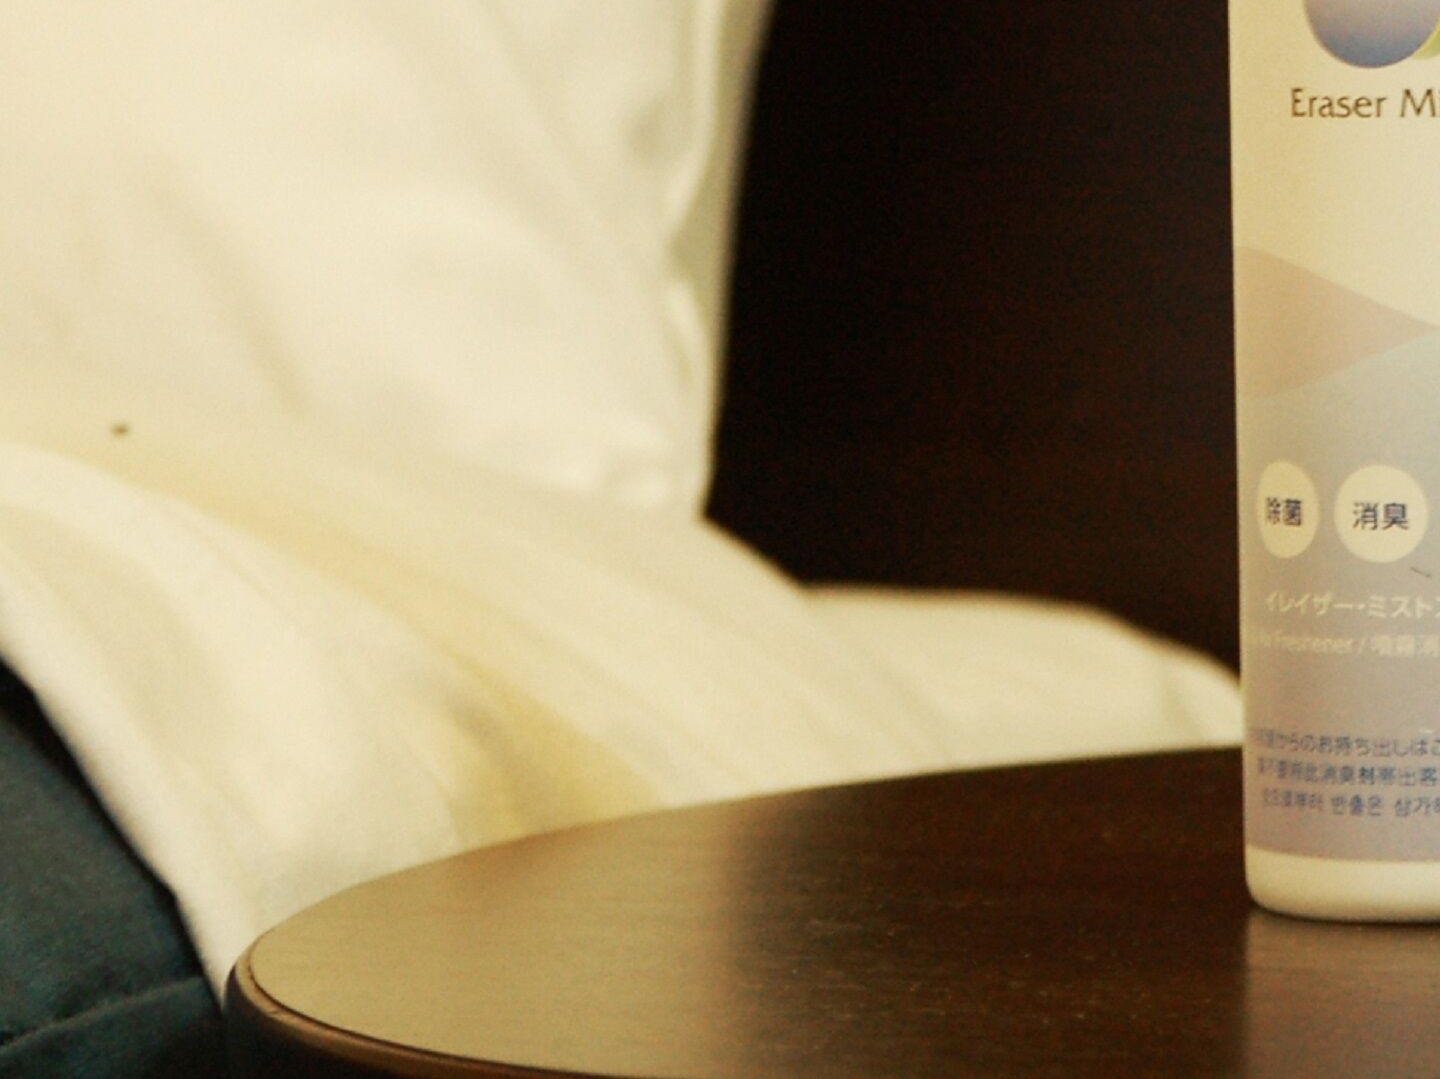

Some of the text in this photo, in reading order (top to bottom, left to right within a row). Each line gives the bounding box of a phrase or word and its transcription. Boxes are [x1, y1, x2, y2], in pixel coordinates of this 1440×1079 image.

[1290, 87, 1387, 118] Eraser
[1265, 497, 1302, 527] 除菌
[1352, 501, 1409, 530] 消臭
